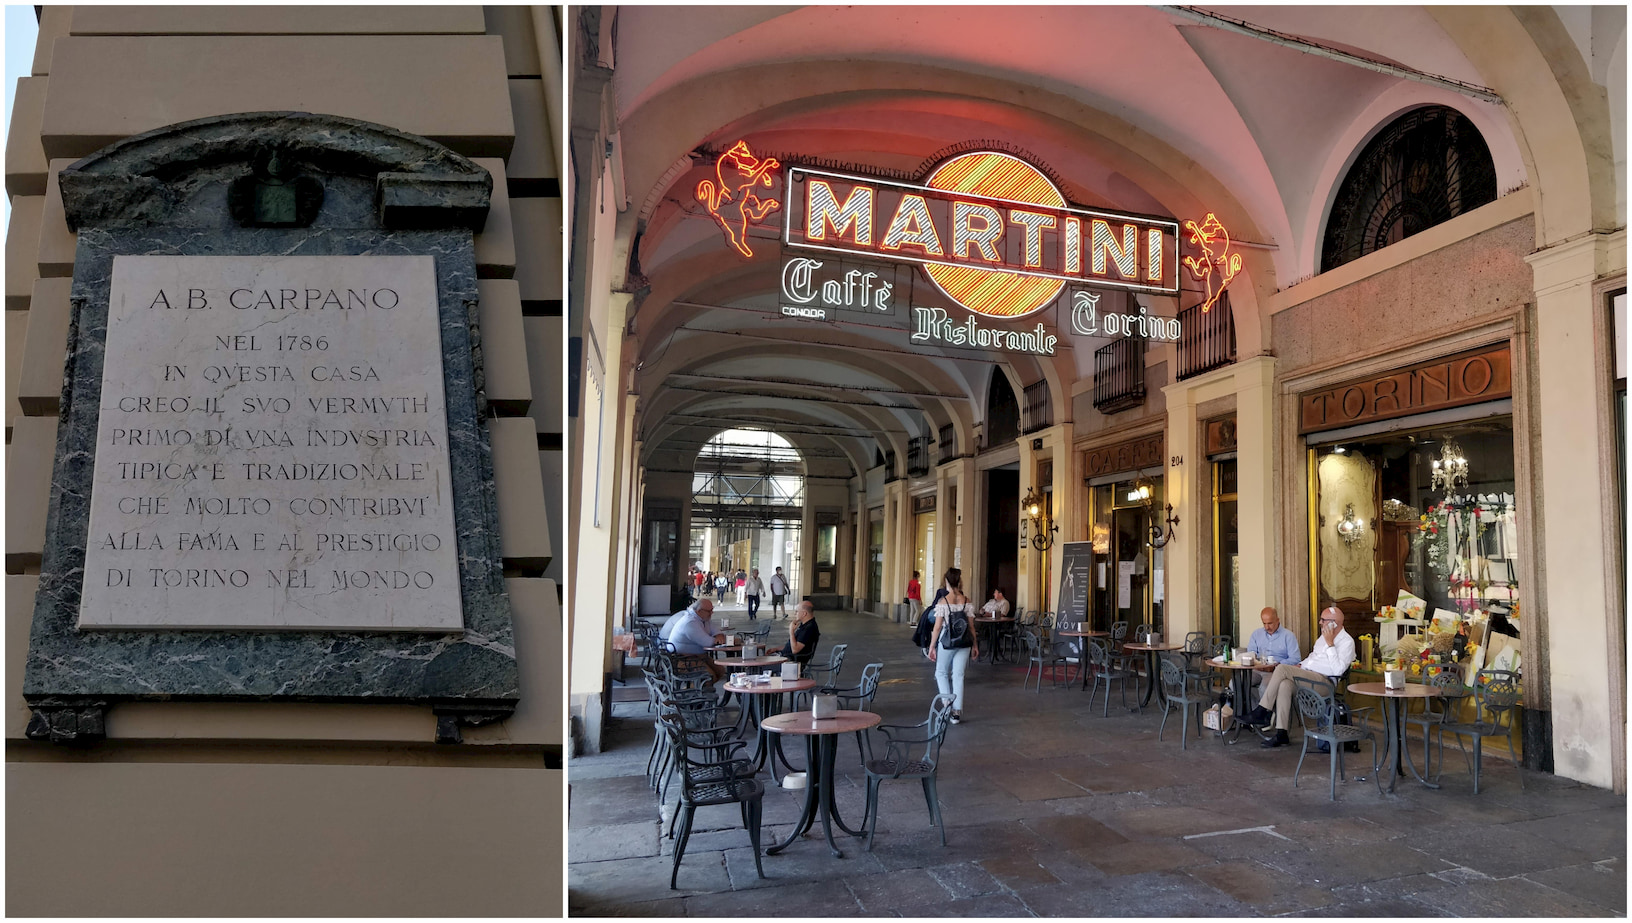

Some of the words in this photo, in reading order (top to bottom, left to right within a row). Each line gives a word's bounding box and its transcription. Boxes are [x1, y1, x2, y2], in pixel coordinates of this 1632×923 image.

[807, 180, 1163, 281] MARTINI
[782, 257, 893, 311] Caffè
[150, 288, 178, 310] A.
[187, 288, 213, 310] B.
[229, 288, 400, 310] CARPANO
[1072, 290, 1182, 341] Torino
[912, 307, 1058, 354] Ristorante
[215, 335, 262, 351] NEL
[277, 335, 330, 351] 1786
[164, 364, 188, 381] IN
[203, 364, 296, 384] QVESTA
[311, 365, 381, 382] CASA
[1312, 356, 1494, 425] TORINO
[205, 396, 226, 414] IL
[242, 397, 292, 414] SVO
[308, 397, 430, 414] VERMVTH
[112, 428, 193, 447] PRIMO
[206, 429, 230, 447] DI
[246, 430, 294, 447] VNA
[307, 429, 436, 448] INDVSTRIA
[118, 461, 199, 480] TIPICA
[212, 462, 226, 480] E
[242, 462, 426, 481] TRADIZIONALE
[1171, 455, 1184, 467] 204
[118, 496, 170, 515] CHE
[185, 496, 272, 515] MOLTO
[103, 533, 164, 551] ALLA
[178, 533, 240, 551] FAMA
[253, 533, 266, 551] E
[279, 533, 304, 551] AL
[316, 533, 442, 552] PRESTIGIO
[106, 568, 132, 588] DI
[149, 568, 249, 589] TORINO
[267, 569, 315, 589] NEL
[331, 569, 435, 590] MONDO
